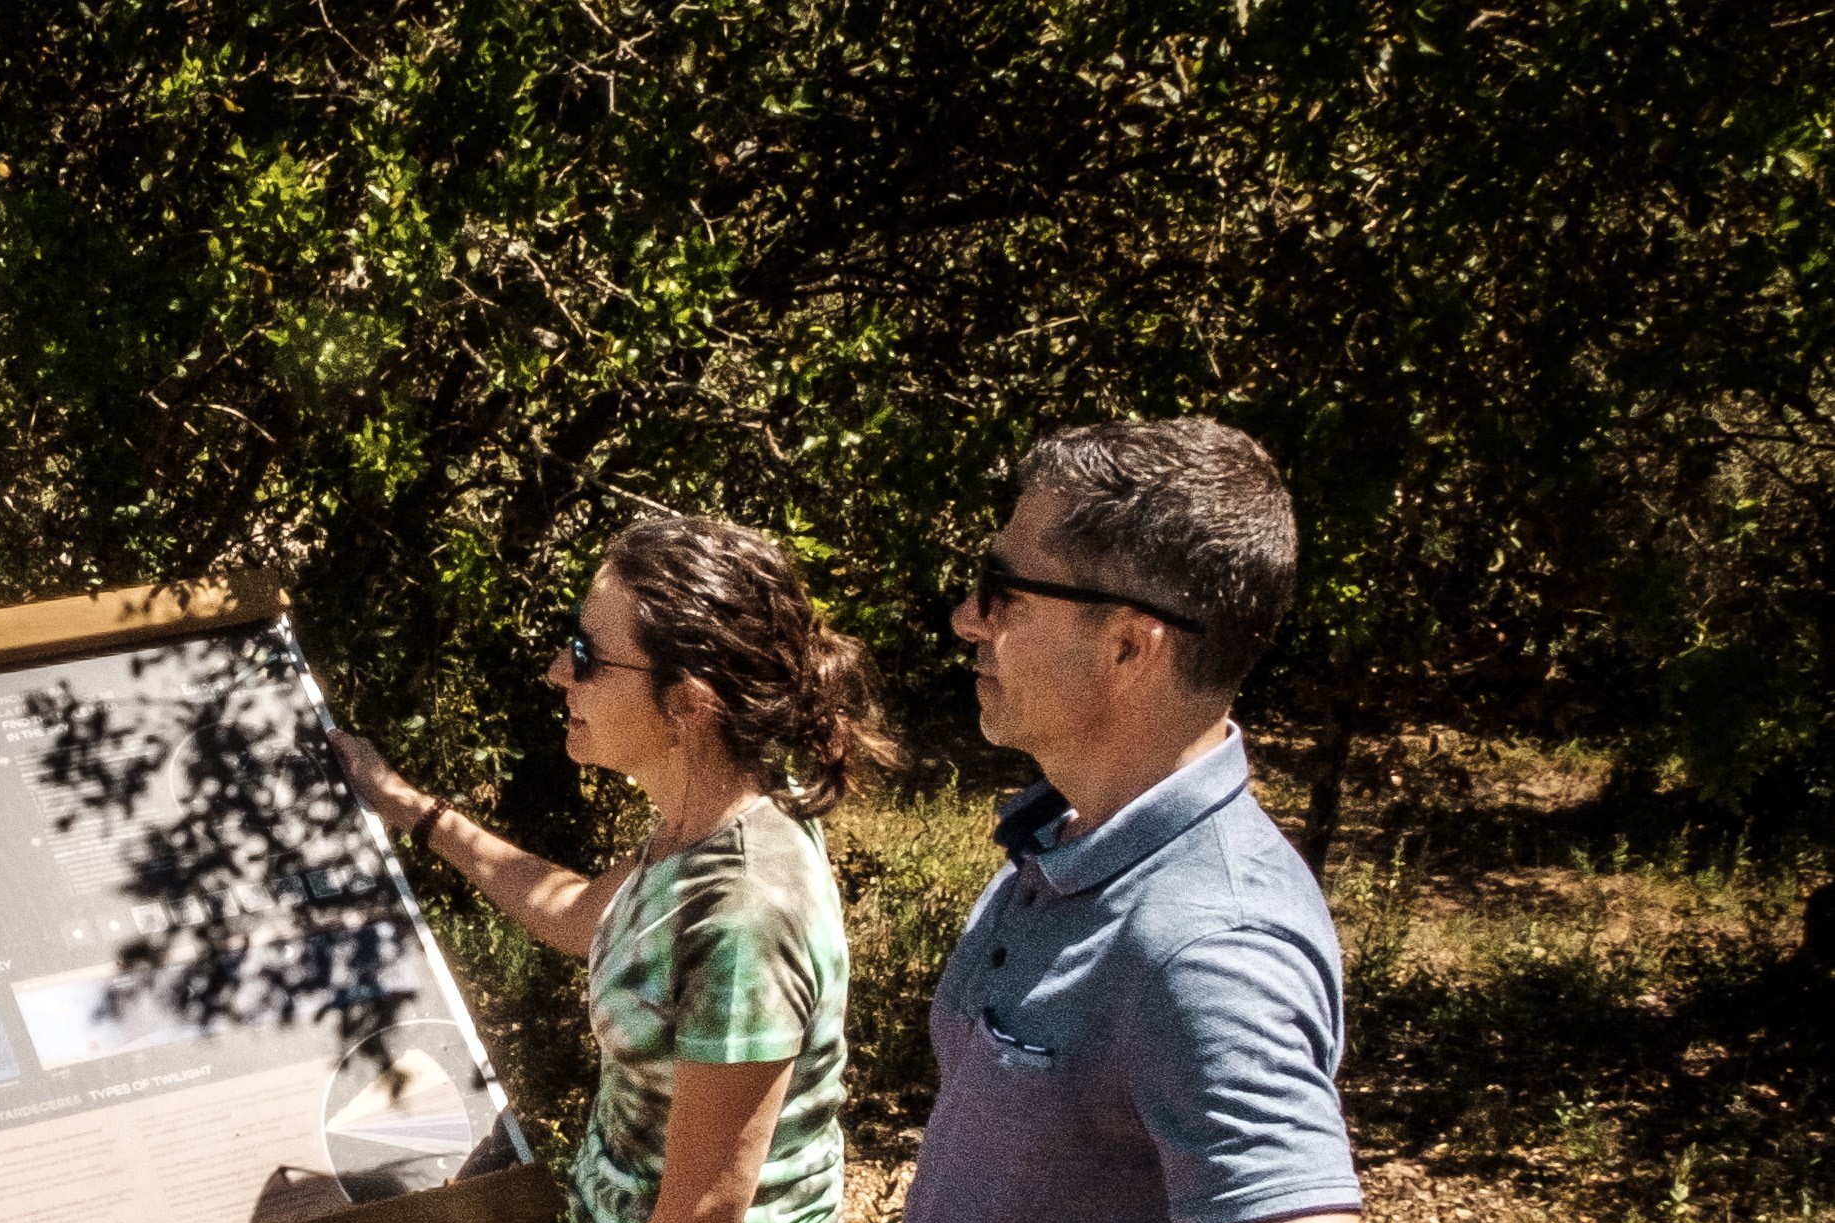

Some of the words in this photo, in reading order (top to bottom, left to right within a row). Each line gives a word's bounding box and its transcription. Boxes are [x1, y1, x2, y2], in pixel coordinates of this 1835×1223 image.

[88, 1082, 132, 1101] TYPES
[133, 1078, 151, 1093] OF
[152, 1065, 212, 1087] TWILIGHT
